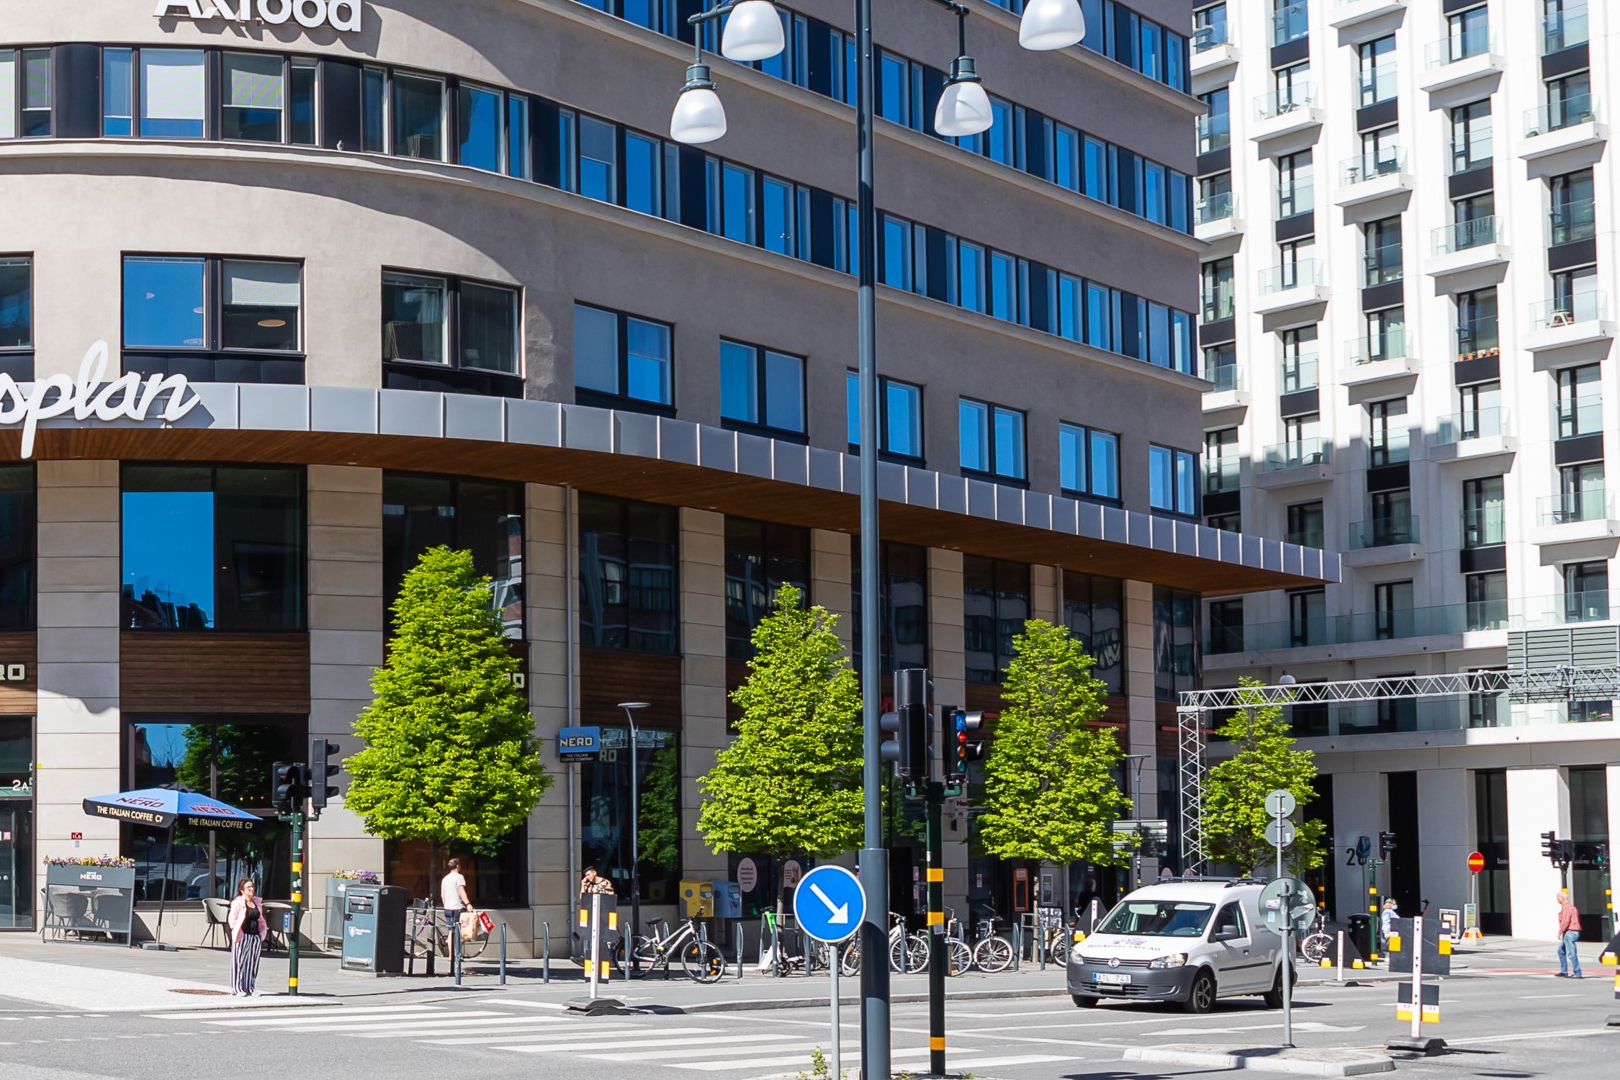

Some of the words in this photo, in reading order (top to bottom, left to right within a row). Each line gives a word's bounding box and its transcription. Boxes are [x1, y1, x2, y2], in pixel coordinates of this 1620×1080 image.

[560, 737, 593, 747] NERO
[12, 779, 29, 792] 2A
[116, 797, 165, 808] NERO
[96, 805, 108, 815] THE
[109, 807, 130, 818] ITALIAN
[130, 810, 154, 822] COFFEE
[188, 805, 236, 815] NERO
[188, 817, 199, 826] THE
[199, 818, 221, 827] ITALIAN
[221, 820, 243, 829] COFFEE
